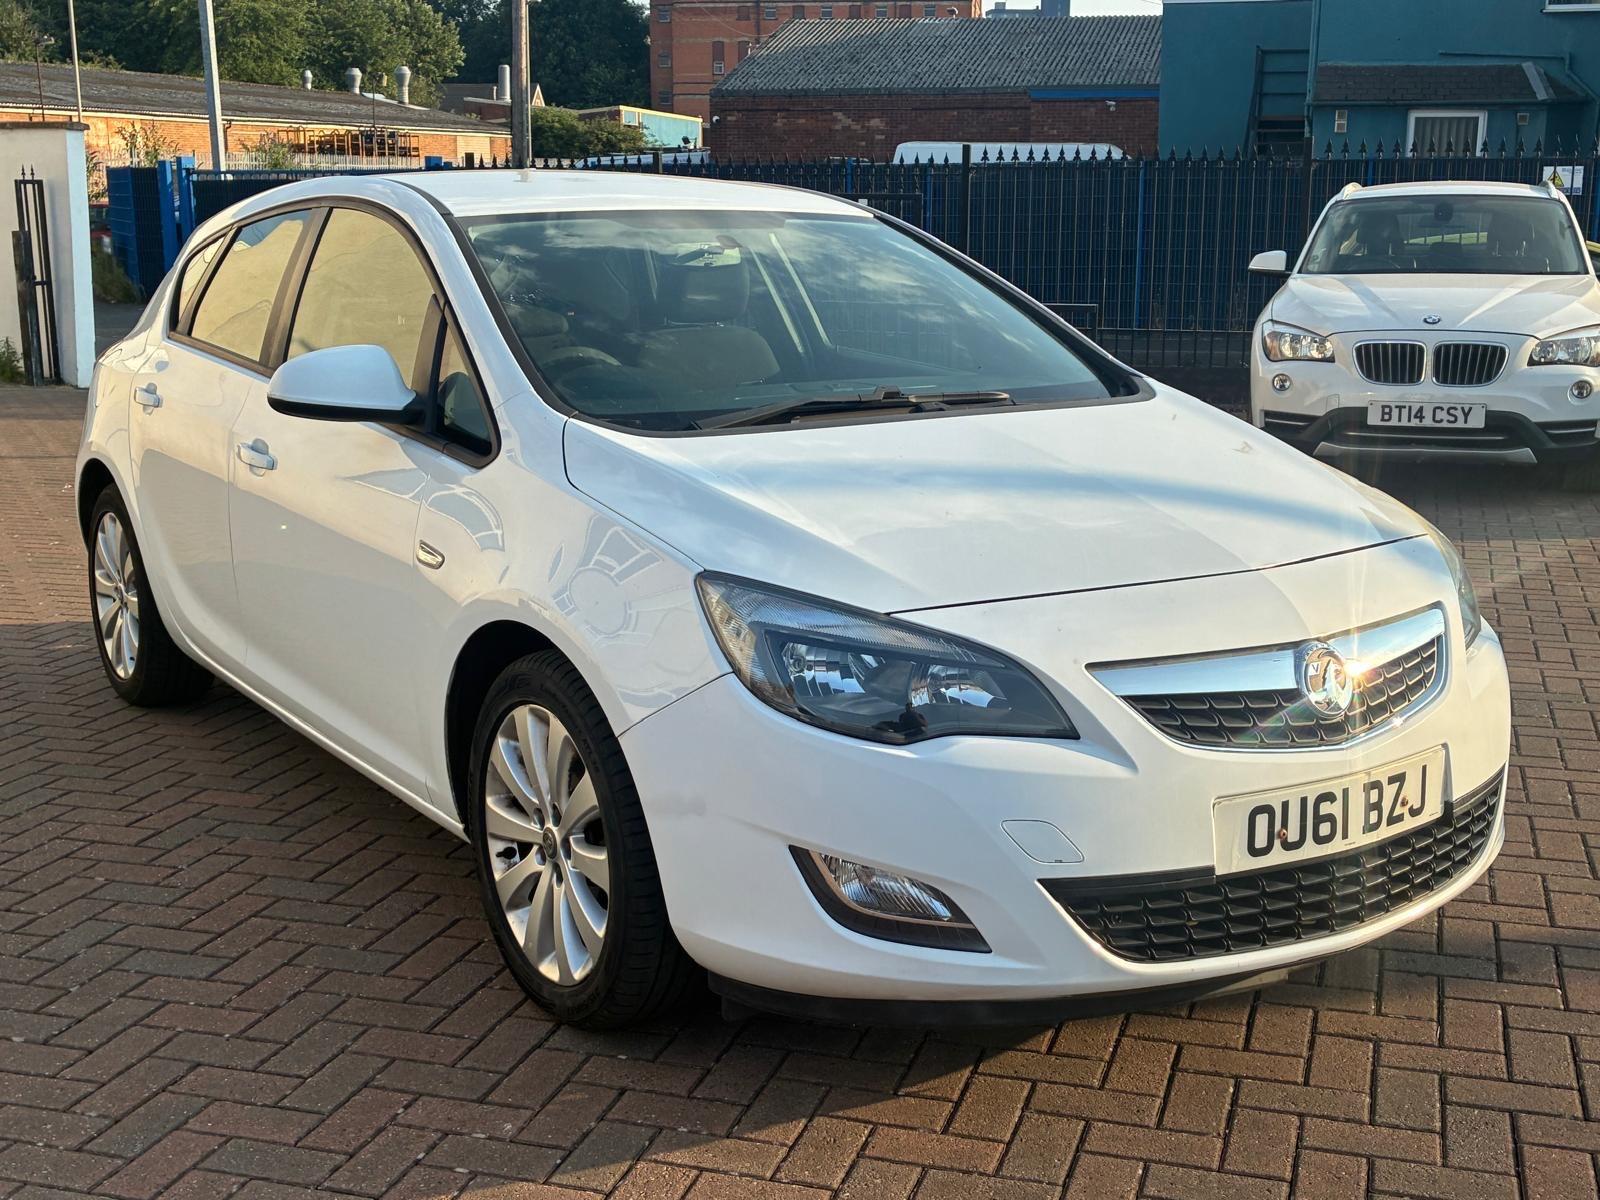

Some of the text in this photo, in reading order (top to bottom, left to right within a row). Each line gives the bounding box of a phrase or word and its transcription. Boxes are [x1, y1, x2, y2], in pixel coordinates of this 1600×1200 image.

[1380, 405, 1473, 424] BT14 CSY
[1247, 764, 1428, 858] OU61 BZJ
